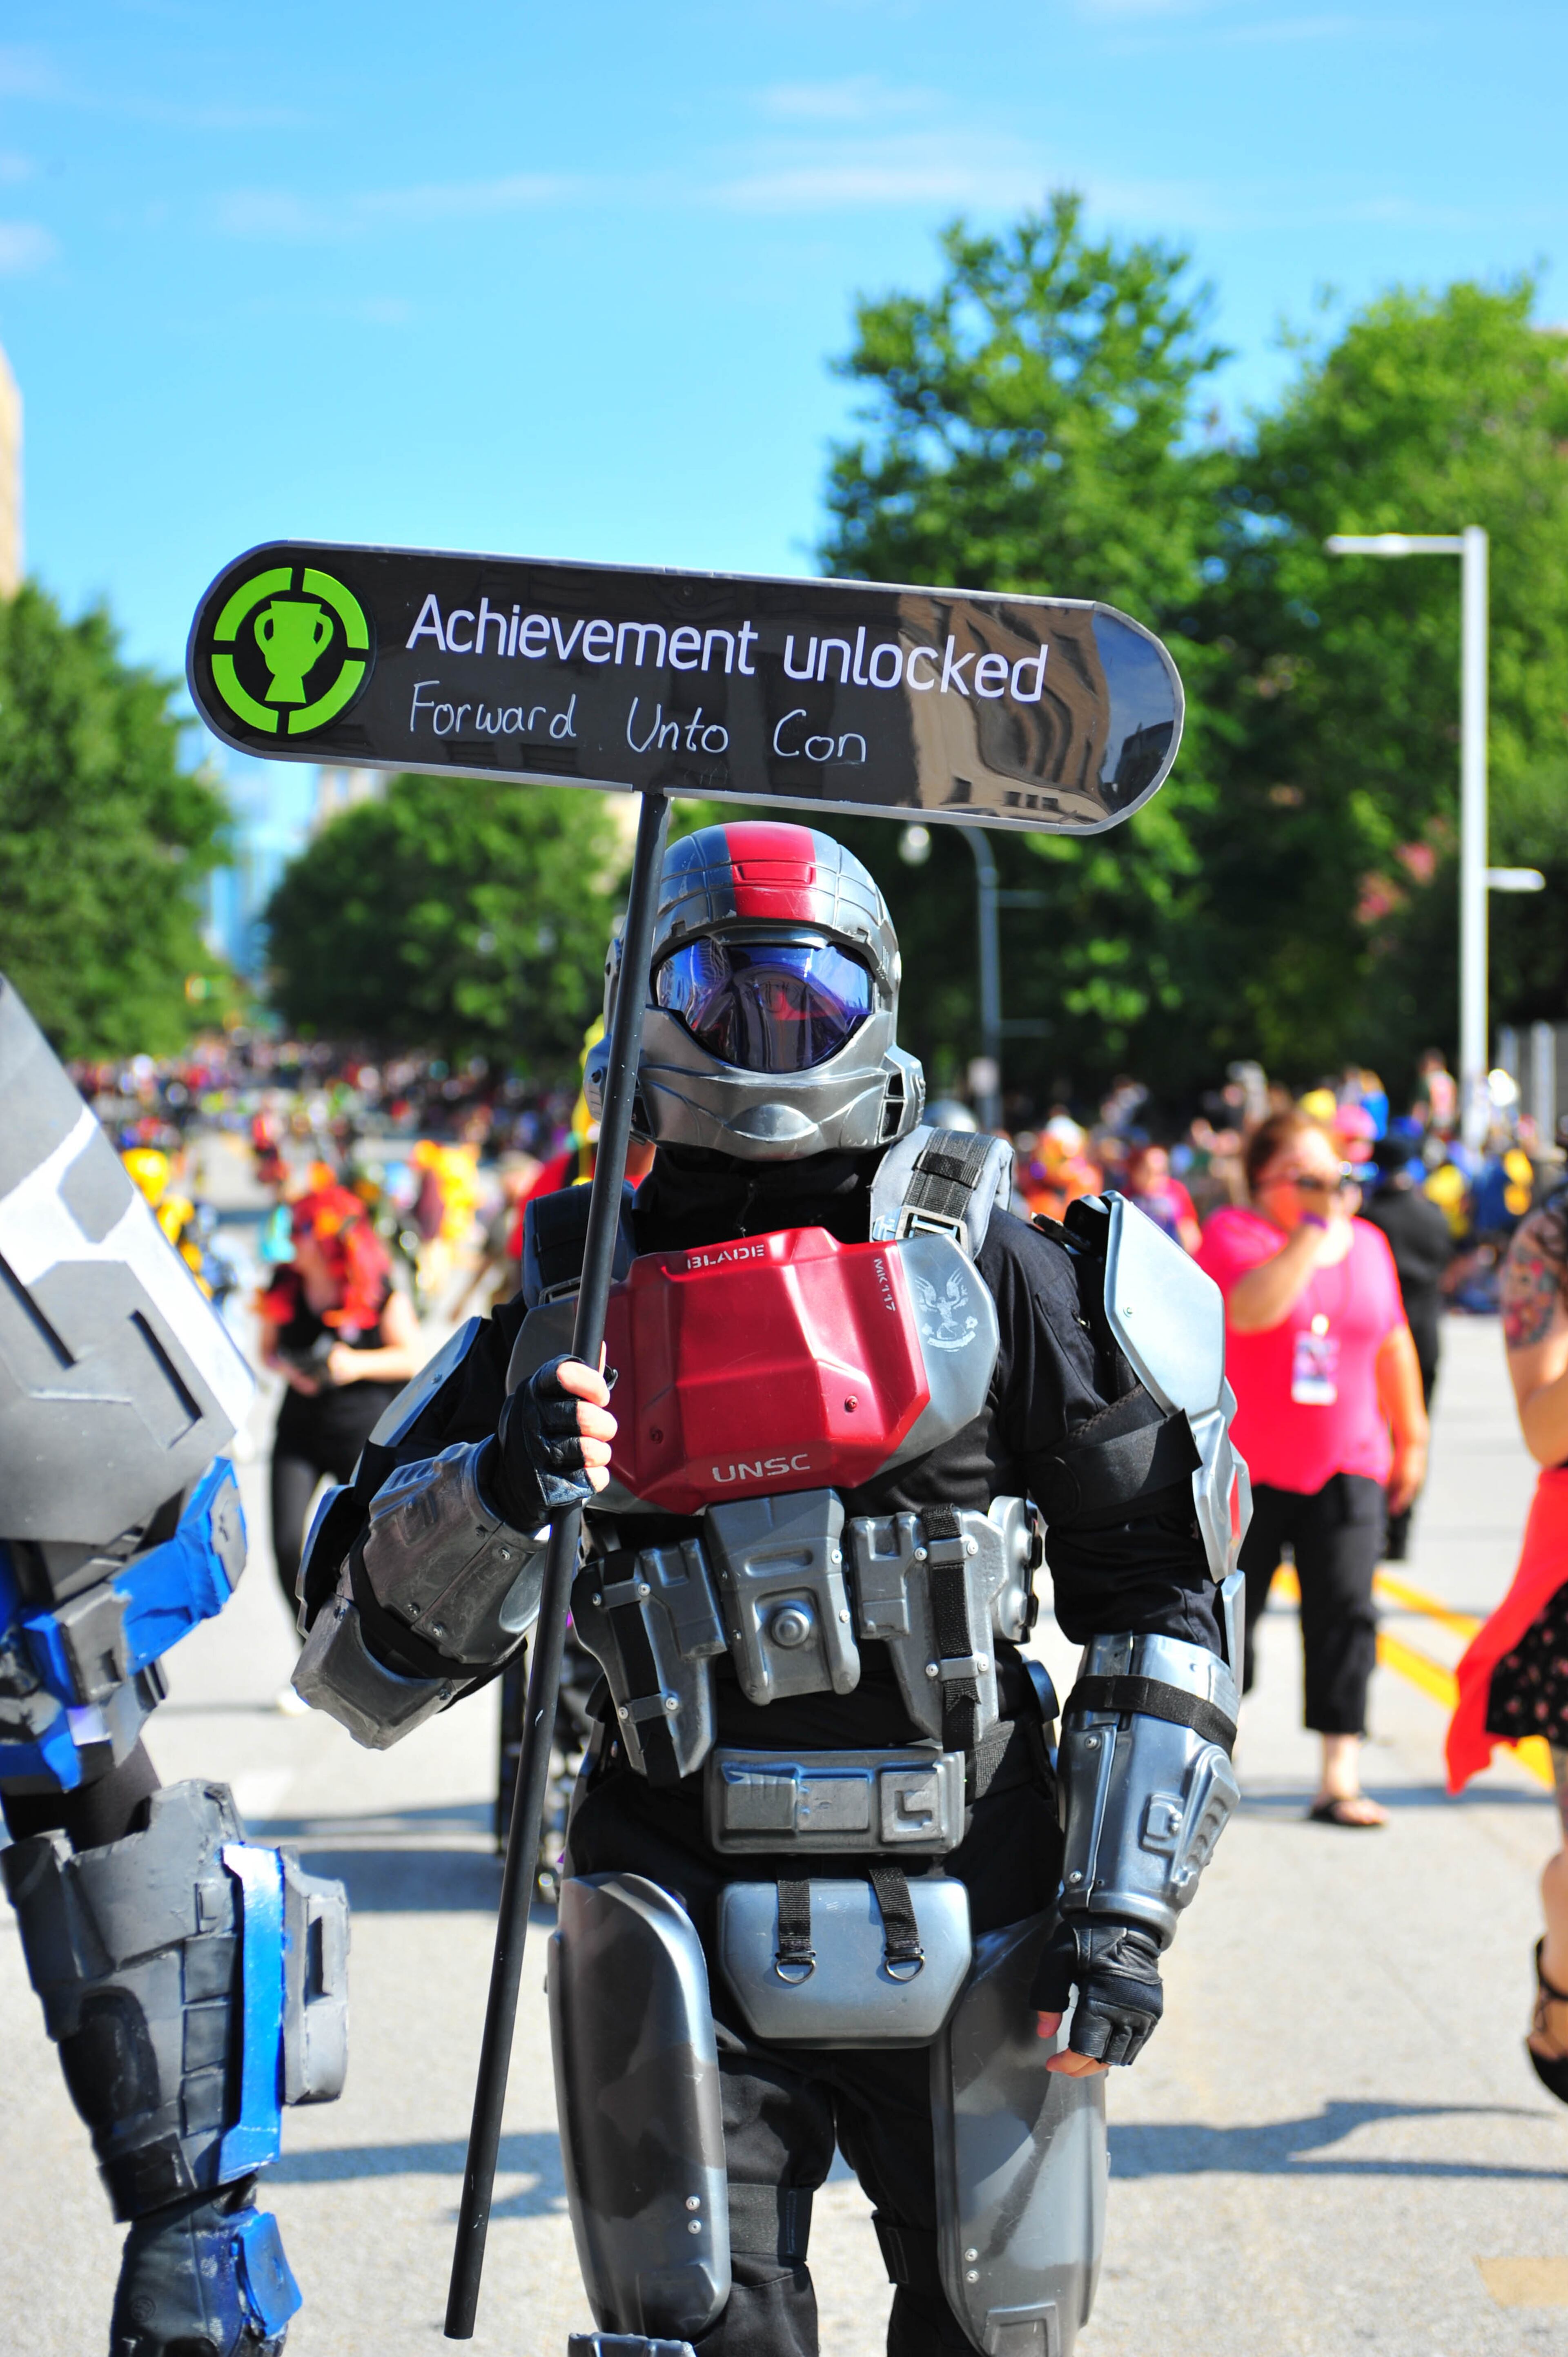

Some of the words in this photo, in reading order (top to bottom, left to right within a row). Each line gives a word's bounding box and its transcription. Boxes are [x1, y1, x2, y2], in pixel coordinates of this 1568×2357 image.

[406, 593, 758, 675] Achievement
[783, 626, 1049, 702] unlocked
[410, 680, 577, 739] Forward
[626, 697, 729, 753] Unto
[773, 709, 866, 763] Con
[687, 1244, 764, 1269] BLADE
[712, 1453, 811, 1483] UNSC
